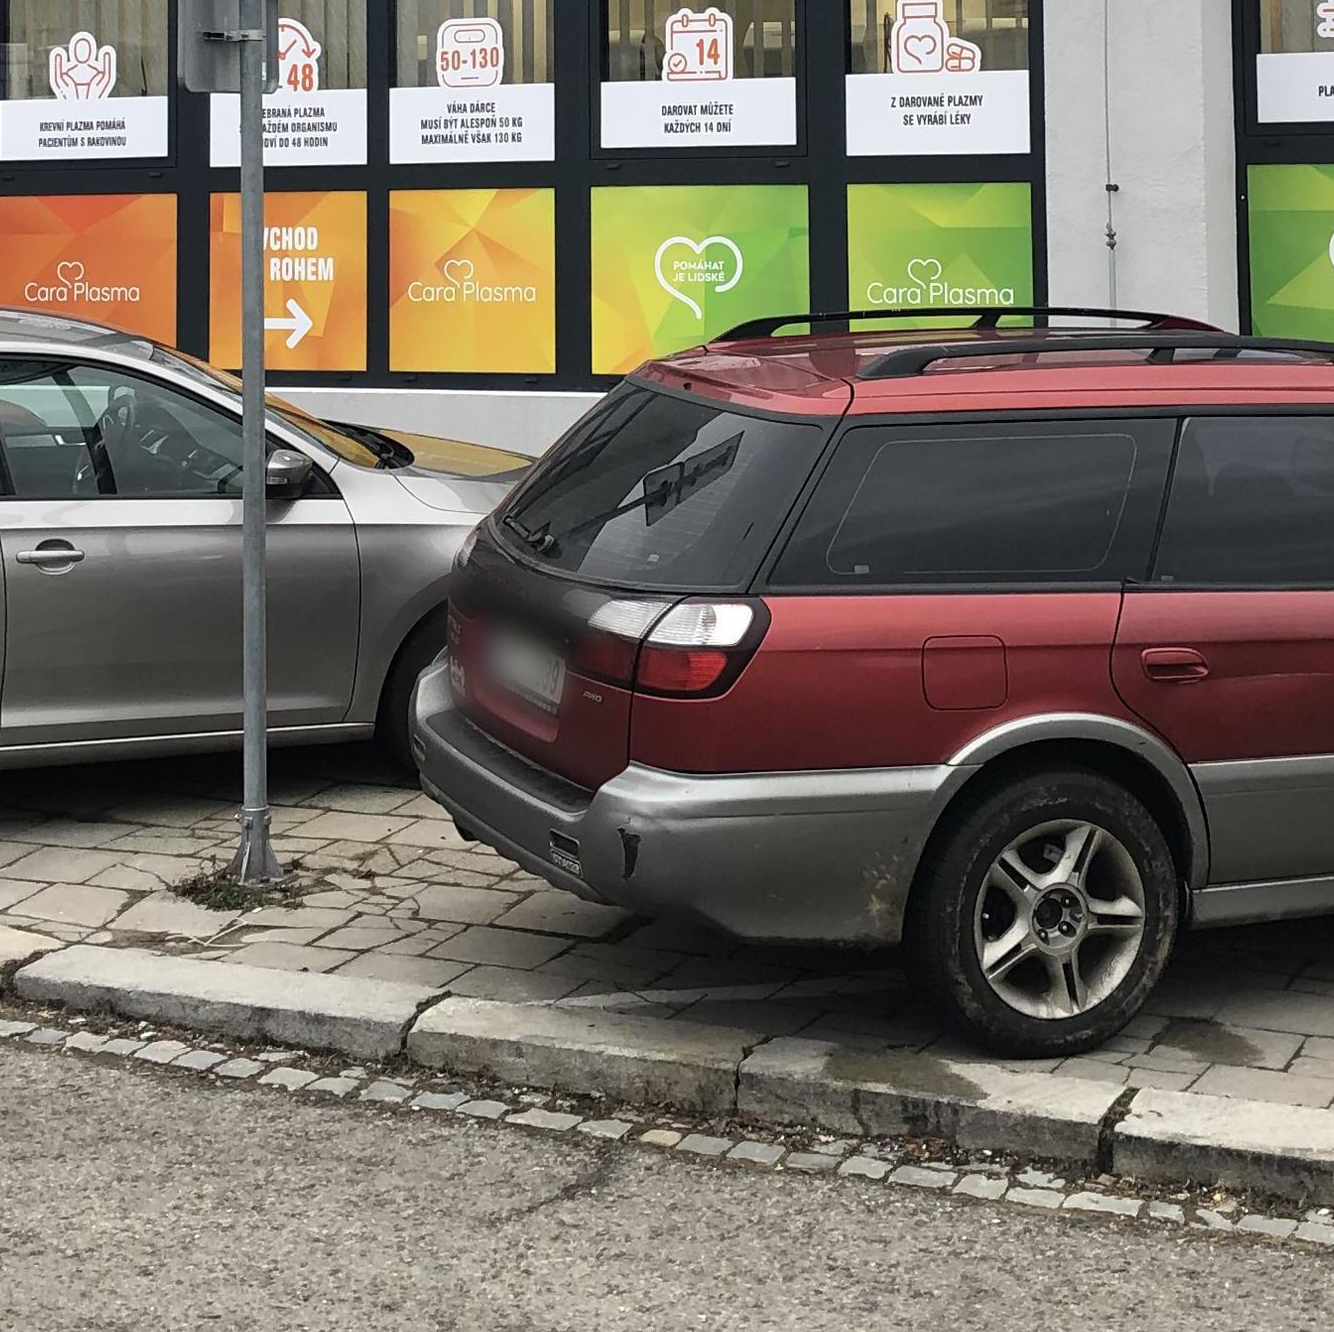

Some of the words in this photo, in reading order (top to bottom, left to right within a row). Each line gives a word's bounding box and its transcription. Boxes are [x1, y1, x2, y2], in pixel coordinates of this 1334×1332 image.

[440, 47, 499, 71] 50-130
[696, 37, 720, 66] 14
[287, 63, 314, 92] 48
[447, 100, 467, 114] VÁHA
[470, 99, 496, 113] DÁRCE
[890, 96, 897, 108] Z
[899, 92, 945, 108] DAROVANÉ
[947, 95, 983, 107] PLAZMY
[294, 107, 325, 118] PLAZMA
[661, 104, 698, 116] DAROVAT
[700, 101, 733, 115] MŮŽETE
[39, 119, 64, 132] KREVNÍ
[66, 121, 94, 131] PLAZMA
[96, 117, 126, 130] POMÁHÁ
[420, 116, 442, 130] MUSÍ
[443, 116, 458, 129] BÝT
[460, 114, 497, 128] ALESPOŇ
[499, 117, 510, 128] 50
[512, 116, 523, 128] KG
[664, 119, 701, 133] KAŽDÝCH
[704, 122, 714, 132] 14
[716, 118, 732, 132] DNÍ
[903, 114, 914, 126] SE
[917, 110, 948, 125] VYRÁBÍ
[949, 110, 971, 125] LÉKY
[262, 120, 288, 133] AŽDÉM
[291, 122, 337, 133] ORGANISMU
[81, 137, 85, 146] S
[87, 136, 127, 146] RAKOVINOU
[279, 138, 289, 148] DO
[292, 137, 301, 148] 48
[304, 136, 328, 147] HODIN
[421, 130, 469, 144] MAXIMÁLNĚ
[471, 130, 492, 144] VŠAK
[495, 132, 509, 143] 130
[511, 132, 522, 143] KG
[270, 257, 334, 282] ROHEM
[673, 257, 725, 271] POMÁHAT
[673, 272, 685, 282] JE
[687, 270, 725, 282] LIDSKÉ
[24, 282, 67, 302] Cara
[74, 282, 139, 301] Plasma
[407, 282, 456, 302] Cara
[462, 281, 537, 302] Plasma
[866, 282, 921, 304] Cara
[929, 282, 1014, 304] Plasma
